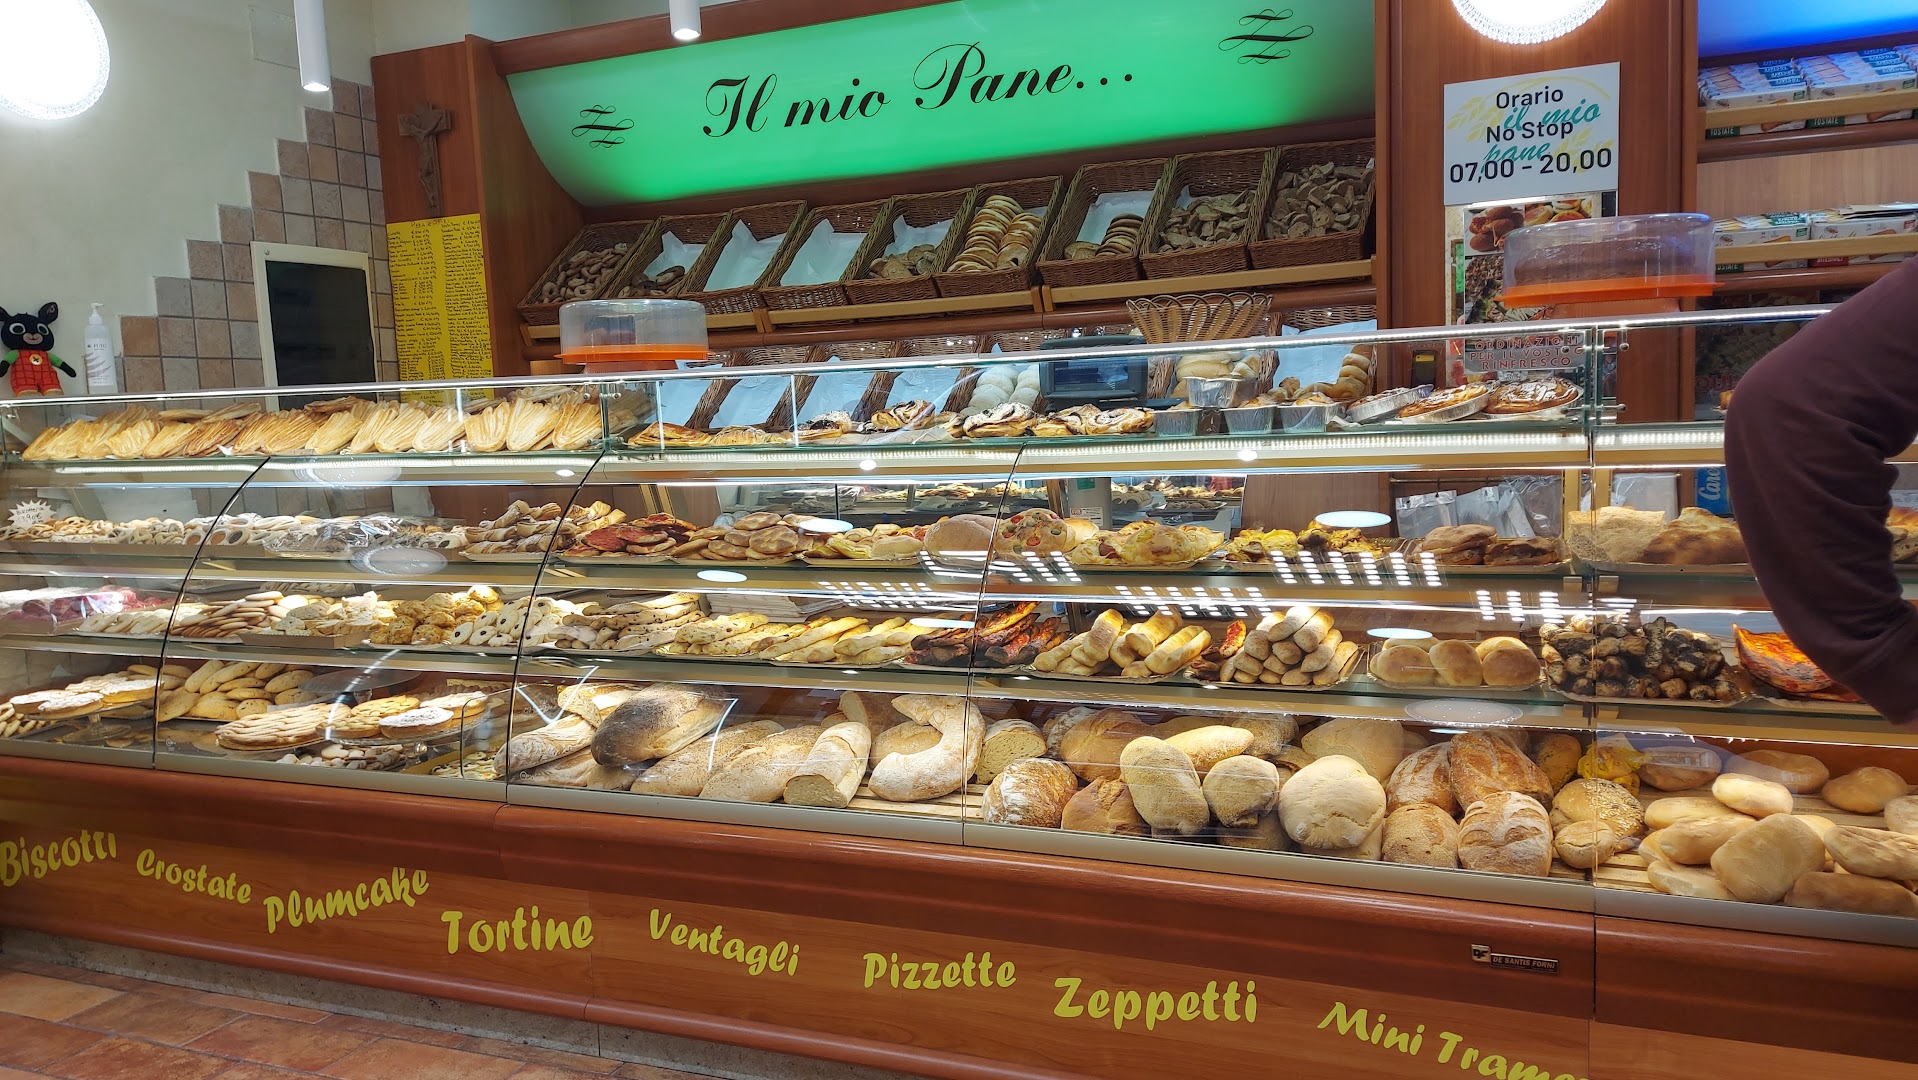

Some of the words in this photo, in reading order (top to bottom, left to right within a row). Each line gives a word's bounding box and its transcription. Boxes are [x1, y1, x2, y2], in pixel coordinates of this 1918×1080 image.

[703, 73, 777, 138] Il
[784, 78, 890, 128] mio
[1496, 86, 1564, 109] Orario
[1541, 98, 1601, 125] mio
[1486, 125, 1515, 144] No
[1521, 121, 1574, 139] Stop
[1450, 156, 1515, 183] 07,00
[1539, 147, 1612, 174] 20,00
[1470, 352, 1495, 361] PER
[1502, 350, 1515, 359] IL
[1521, 347, 1584, 358] VOSTO
[1482, 357, 1571, 370] RINFRESCO
[0, 829, 117, 887] Biscotti
[137, 849, 252, 904] Crostate
[263, 867, 429, 934] Plumcake
[441, 906, 593, 955] Tortine
[649, 908, 800, 977] Ventagli
[863, 951, 1017, 990] Pizzette
[1493, 956, 1503, 964] DE
[1504, 957, 1530, 967] SANTIS
[1532, 960, 1556, 969] FORNI
[1053, 977, 1258, 1031] Zeppetti
[1317, 1001, 1425, 1056] Mini
